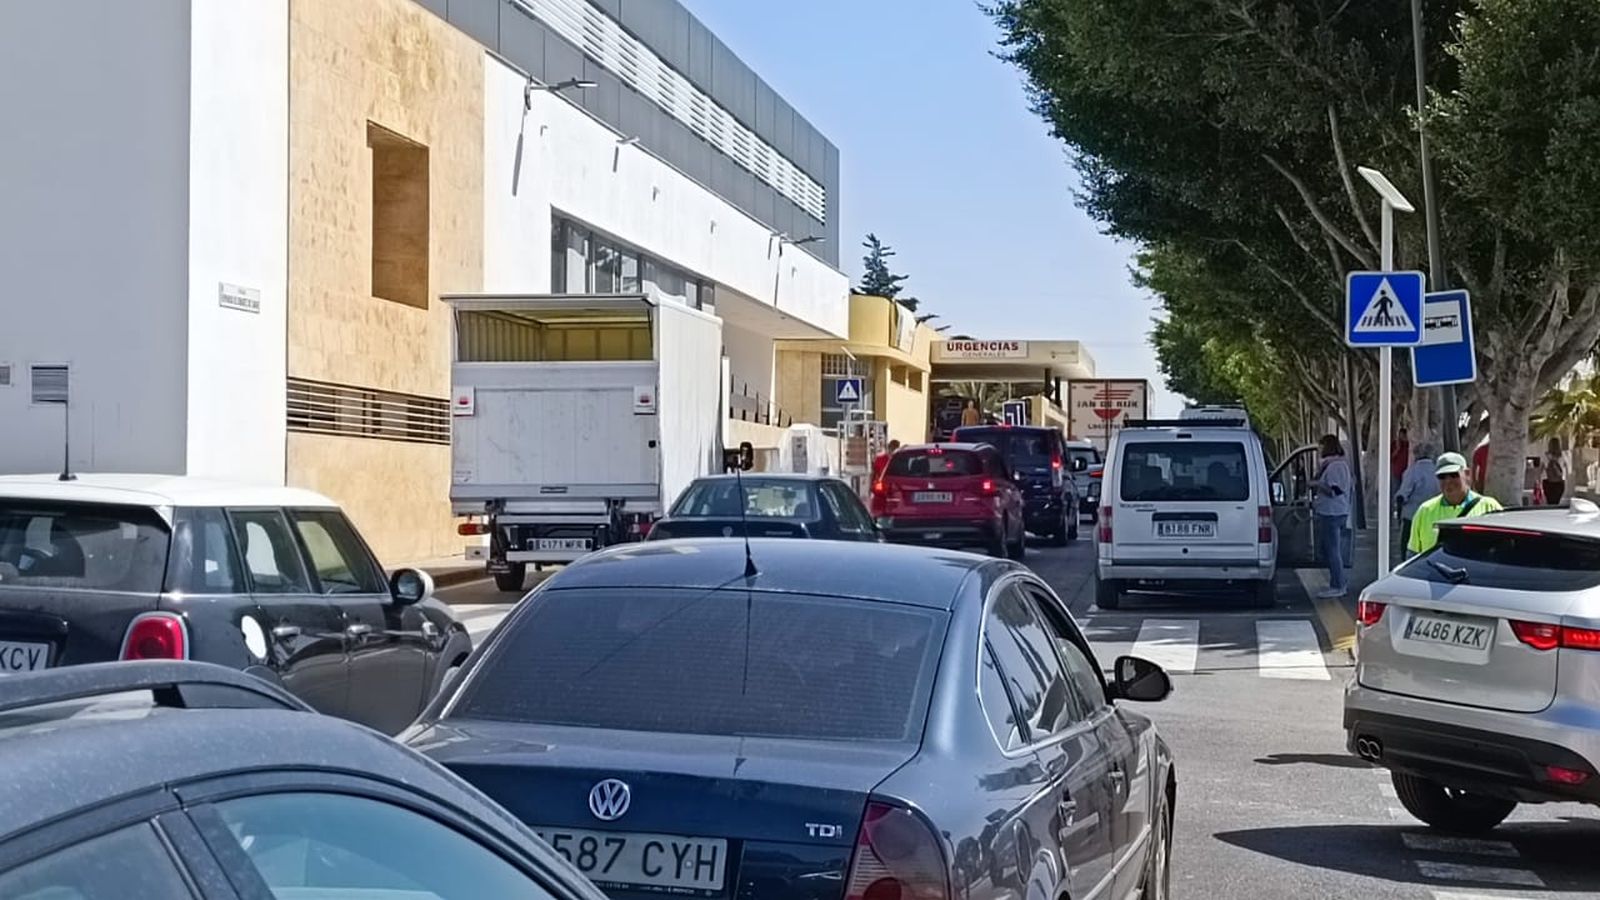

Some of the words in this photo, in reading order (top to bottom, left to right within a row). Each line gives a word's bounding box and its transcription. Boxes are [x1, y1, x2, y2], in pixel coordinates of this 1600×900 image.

[946, 341, 1019, 351] URGENCIAS
[1413, 618, 1451, 641] 4486
[1452, 624, 1486, 647] KZK
[537, 832, 626, 874] 587
[641, 839, 718, 882] CYH
